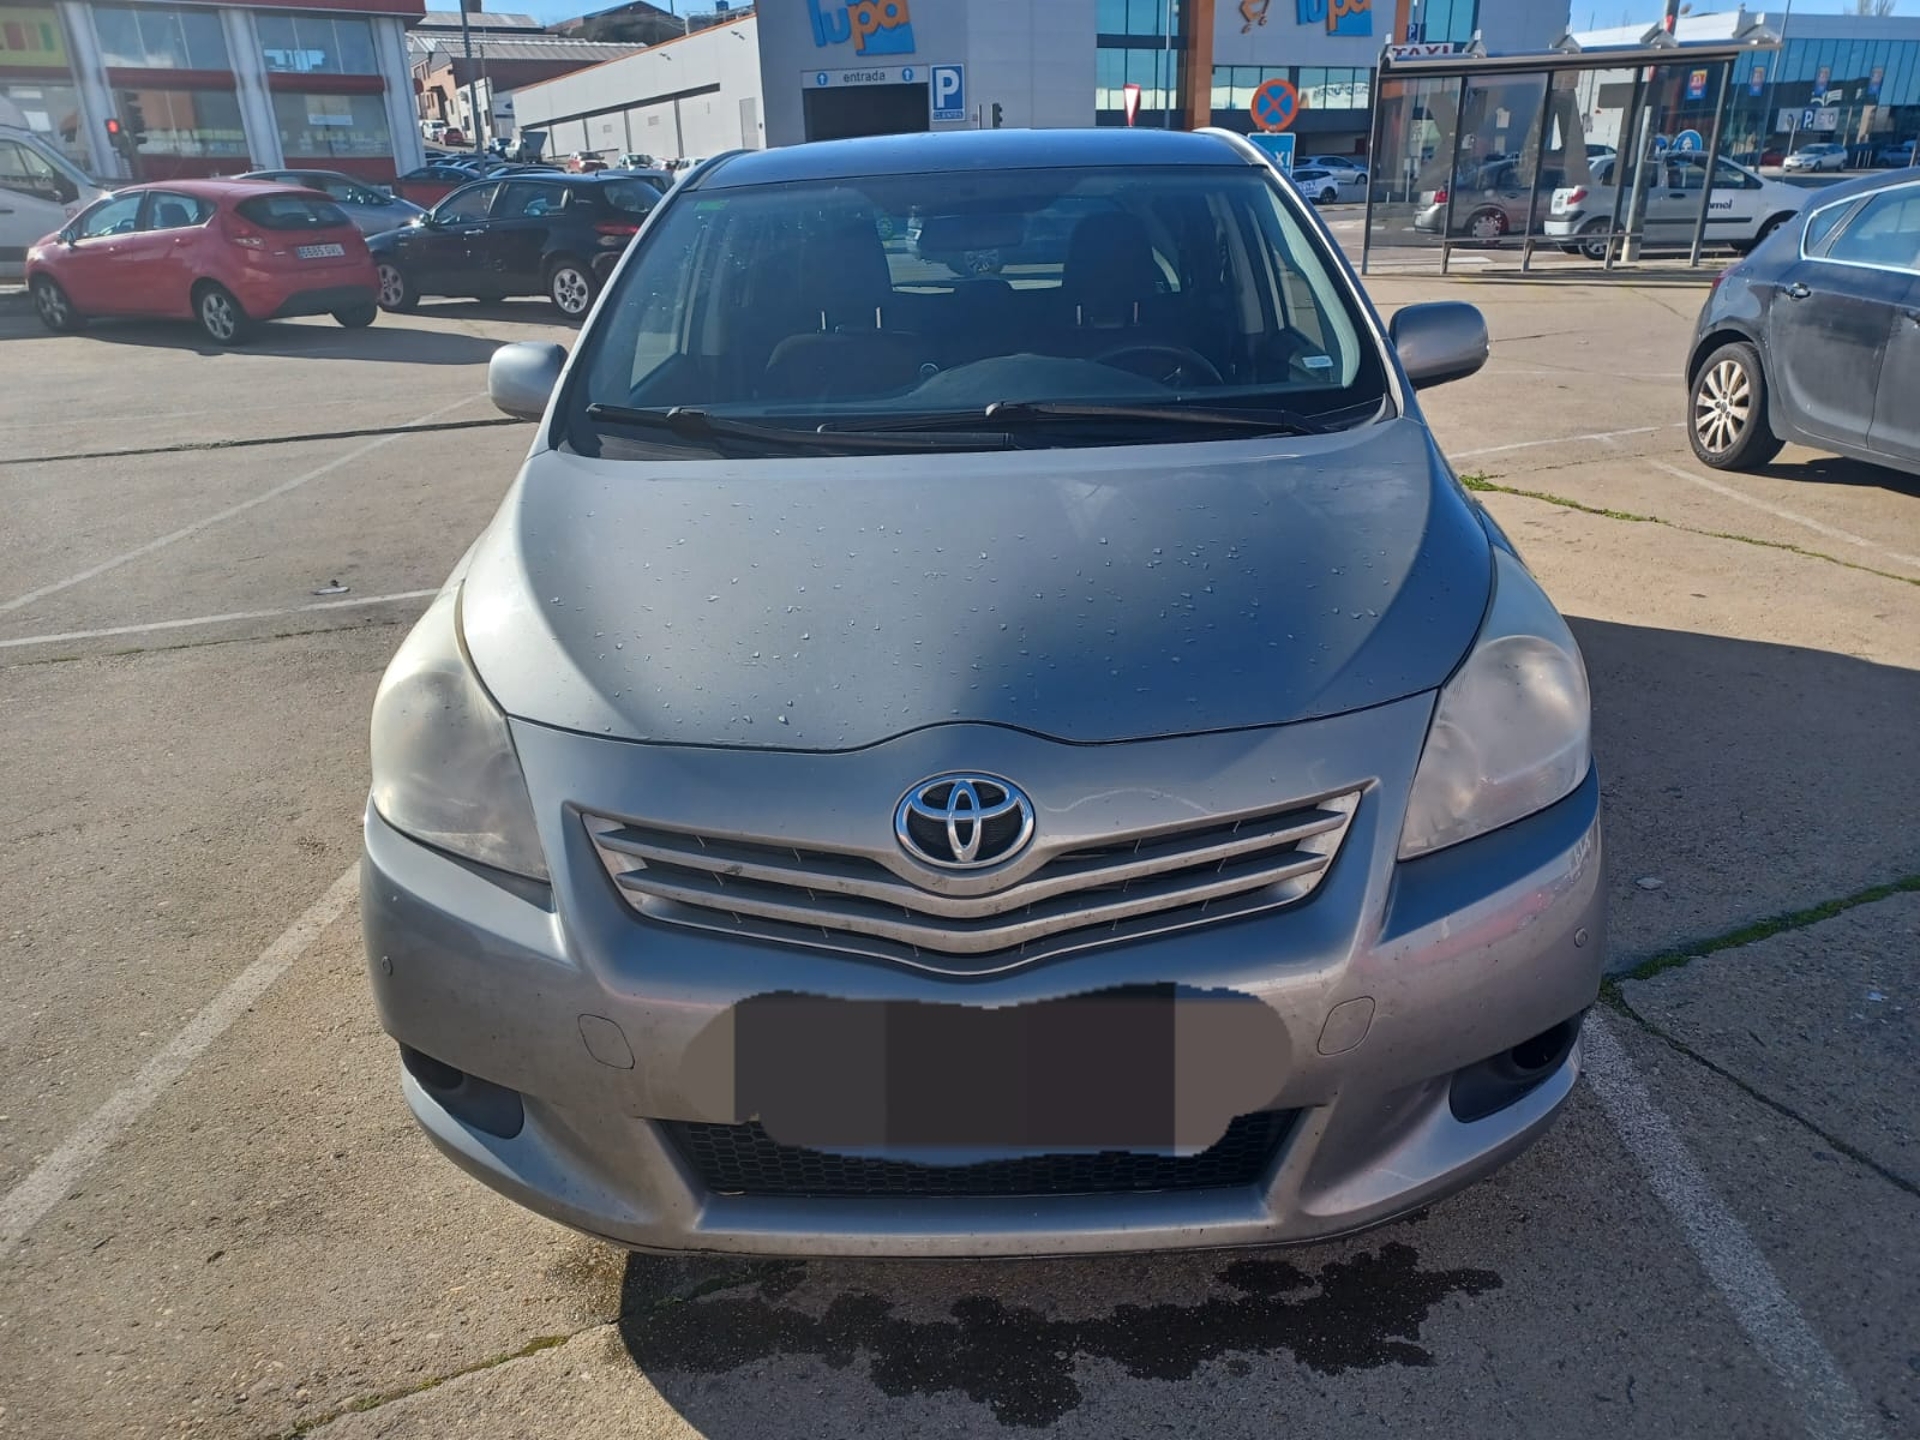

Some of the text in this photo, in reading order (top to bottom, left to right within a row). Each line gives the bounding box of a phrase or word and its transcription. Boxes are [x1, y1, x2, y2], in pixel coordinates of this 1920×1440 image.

[808, 0, 911, 50] lupa
[843, 70, 886, 83] entrada
[935, 68, 960, 109] P
